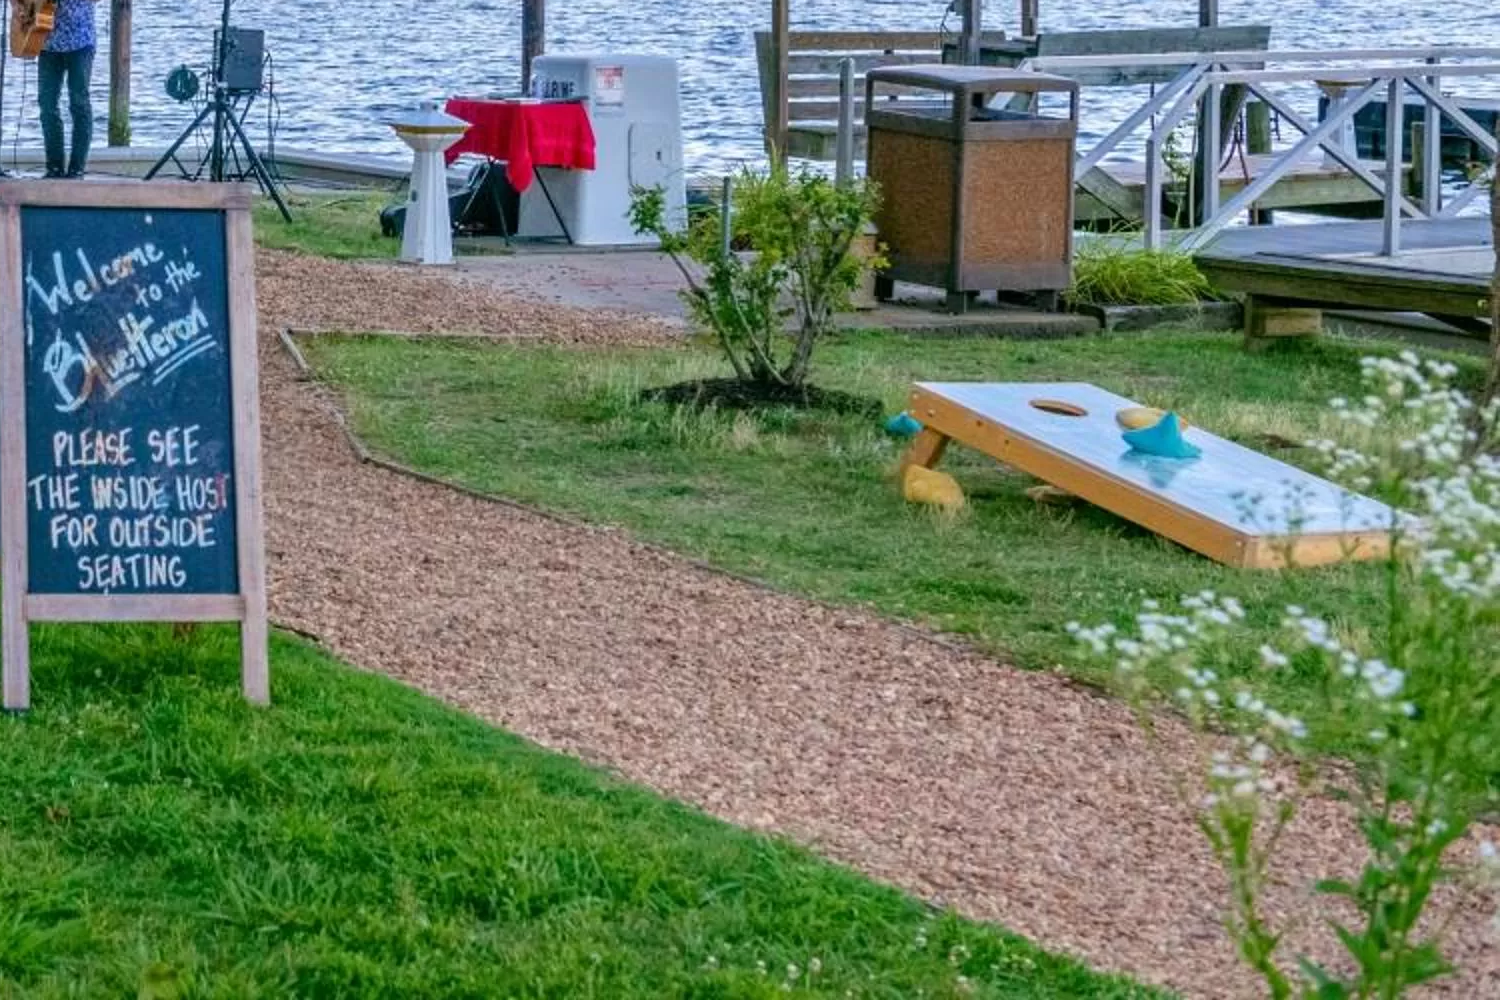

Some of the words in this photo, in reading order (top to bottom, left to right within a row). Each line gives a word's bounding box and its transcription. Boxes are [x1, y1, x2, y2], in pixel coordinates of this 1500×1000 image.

[25, 243, 164, 315] Welcome
[133, 283, 163, 308] to
[163, 260, 201, 293] the
[53, 427, 136, 467] PLEASE
[148, 424, 200, 467] SEE
[28, 473, 81, 510] THE
[91, 475, 170, 510] INSIDE
[176, 472, 230, 511] HOST
[50, 513, 99, 549] FOR
[109, 513, 216, 548] OUTSIDE
[77, 553, 187, 589] SEATING
